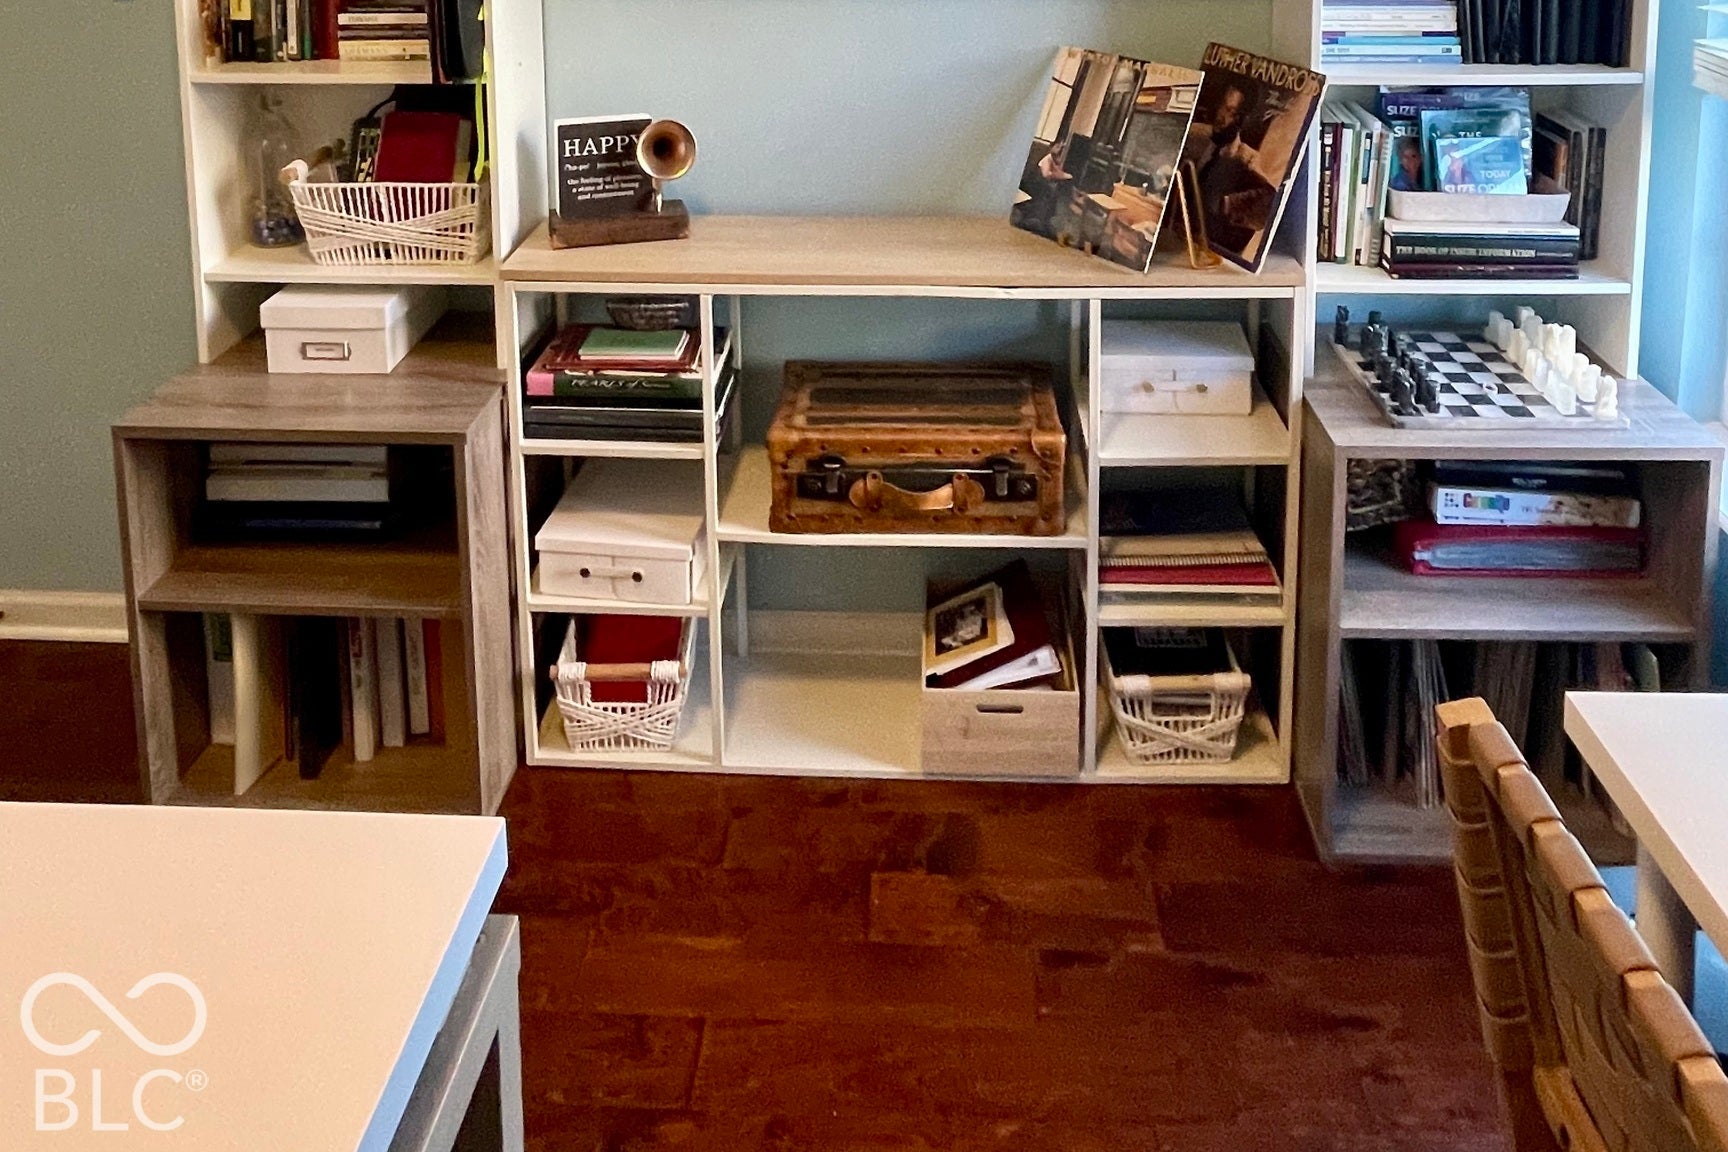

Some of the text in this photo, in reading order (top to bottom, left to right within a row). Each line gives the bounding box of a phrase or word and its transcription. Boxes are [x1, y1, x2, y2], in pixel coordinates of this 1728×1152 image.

[1204, 45, 1324, 96] LUTHER VANDROSS
[1386, 105, 1417, 116] SUZE
[1393, 126, 1418, 137] SUZ
[1480, 170, 1511, 180] TODAY
